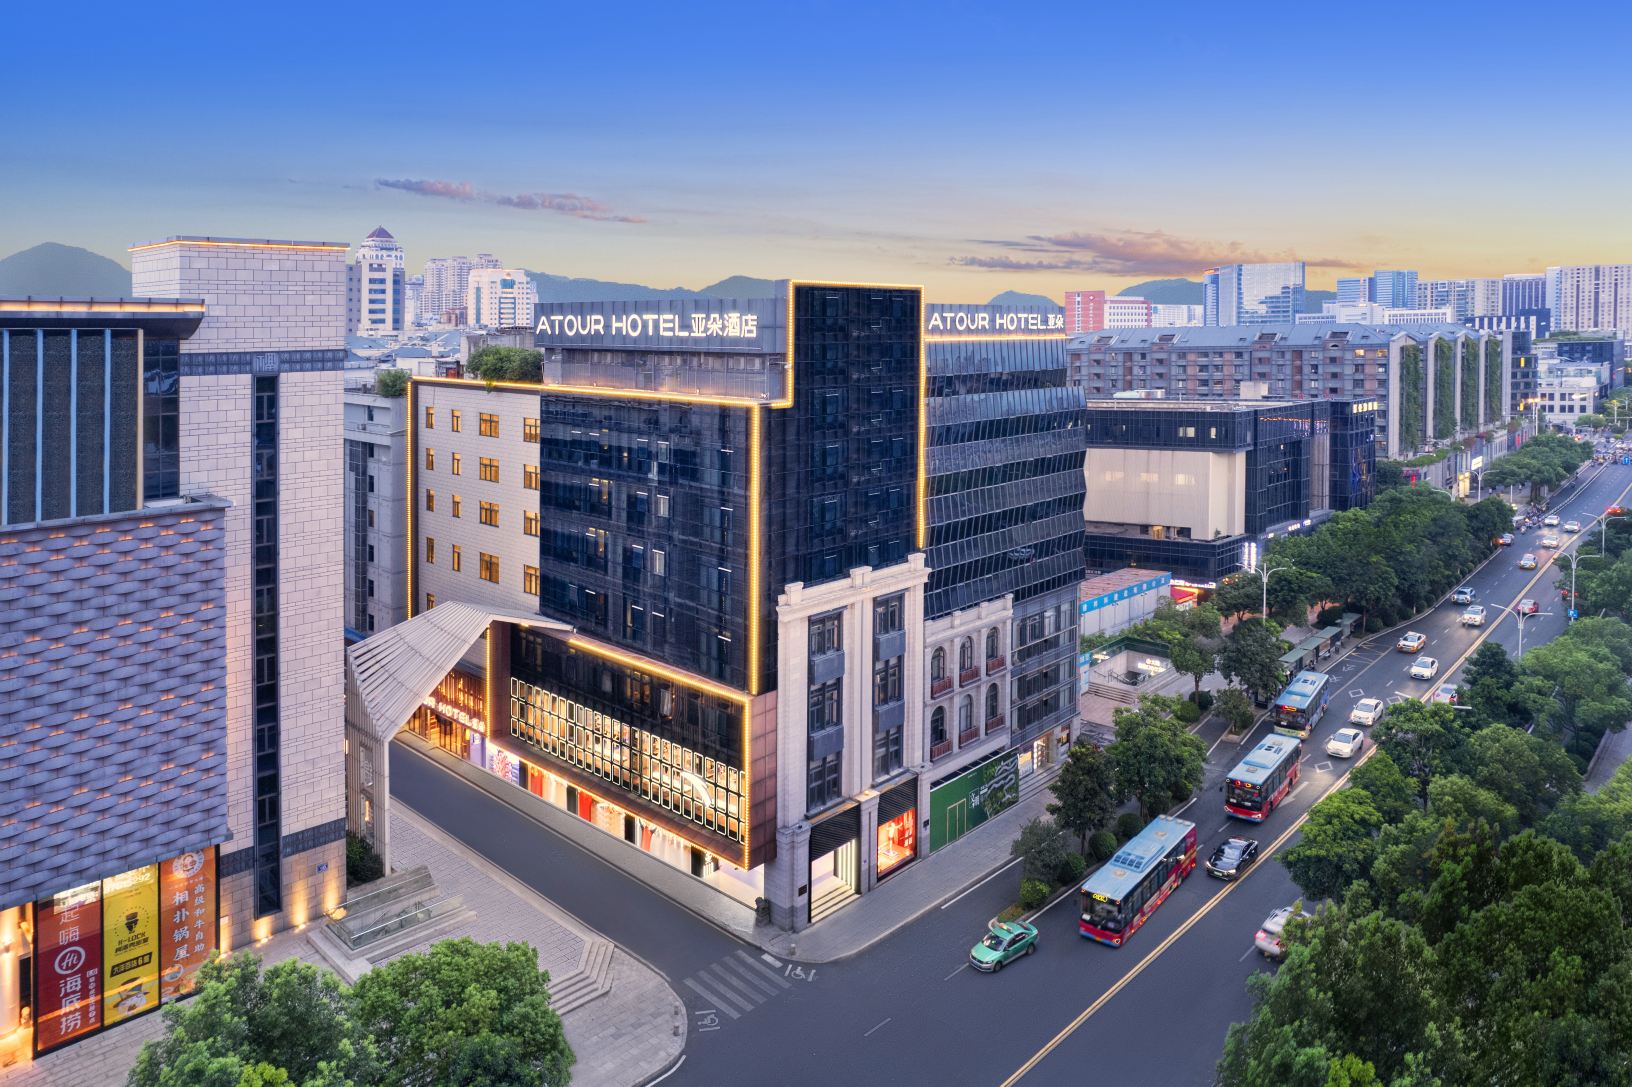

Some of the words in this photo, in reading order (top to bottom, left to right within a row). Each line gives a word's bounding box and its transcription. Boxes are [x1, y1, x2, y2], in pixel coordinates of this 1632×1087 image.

[536, 314, 605, 337] ATOUR
[612, 313, 689, 337] HOTEL
[690, 313, 758, 338] 亚朵酒店
[928, 312, 990, 331] ATOUR
[995, 313, 1047, 331] HOTEL
[1047, 314, 1064, 330] 亚朵
[438, 702, 472, 727] HOTEL
[172, 889, 190, 962] 相扑锅屋
[59, 973, 82, 1036] 海底捞
